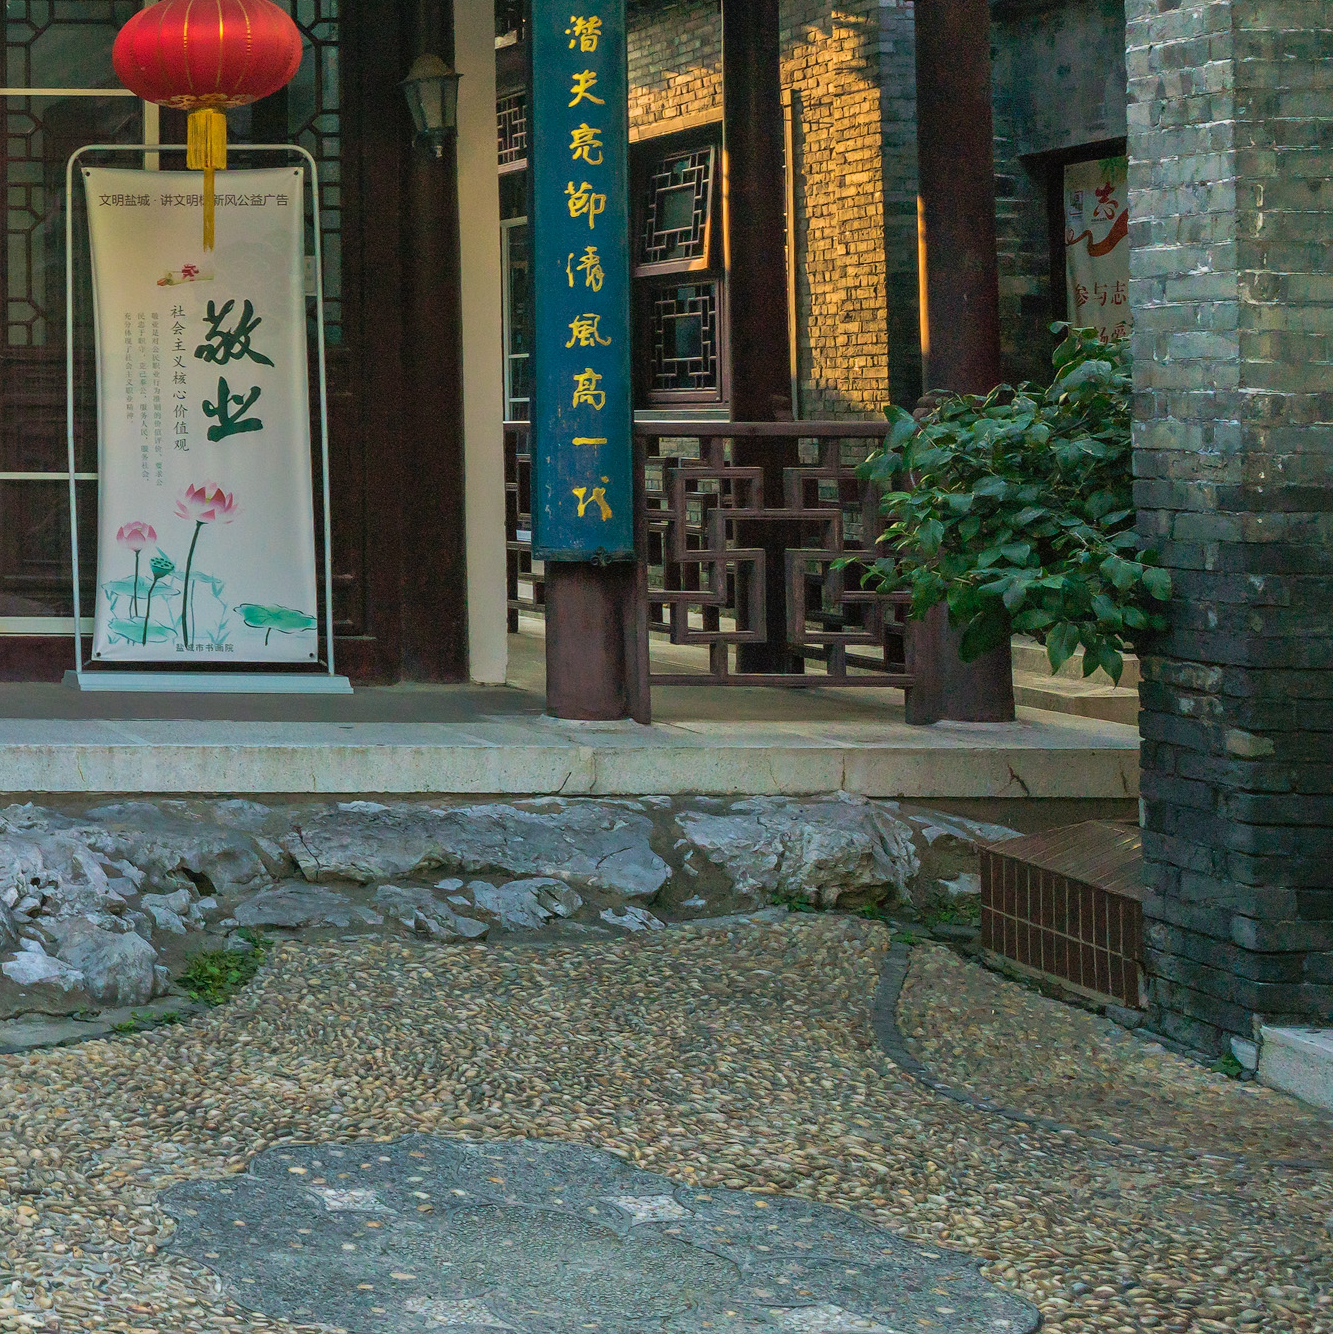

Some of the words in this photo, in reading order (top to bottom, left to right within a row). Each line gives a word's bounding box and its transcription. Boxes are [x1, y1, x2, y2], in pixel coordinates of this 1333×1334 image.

[170, 304, 190, 452] 社会主义核心价值观
[193, 298, 275, 442] 敬业
